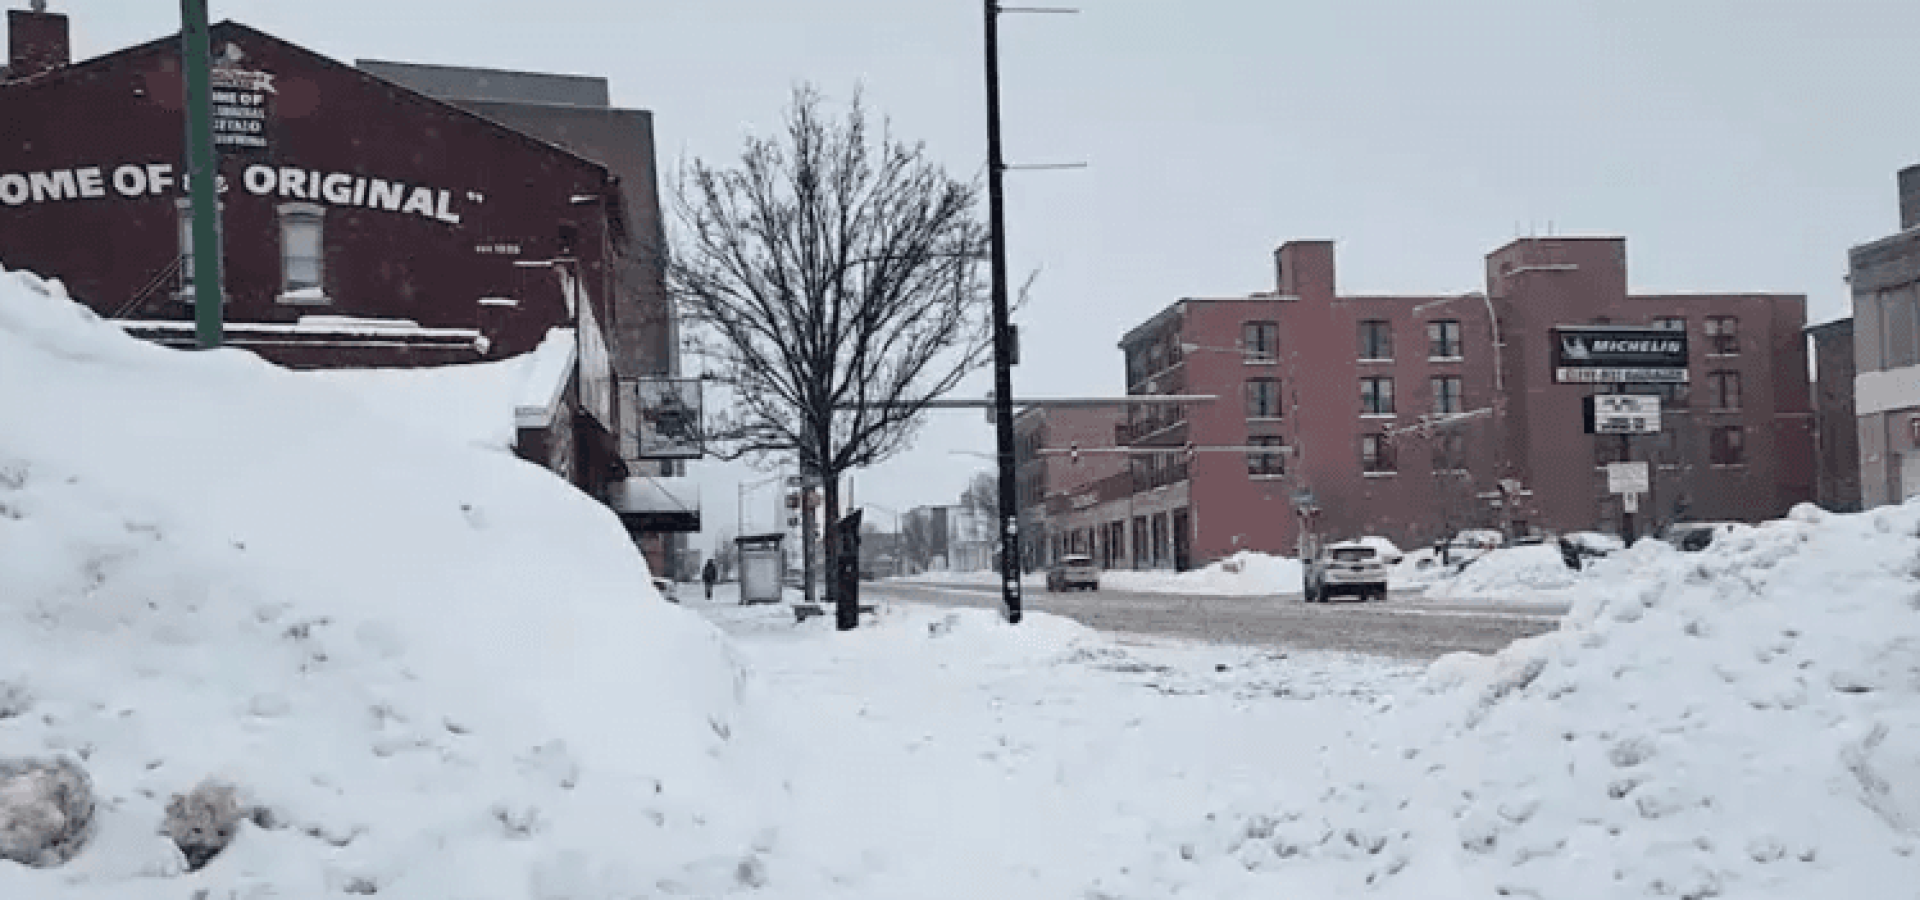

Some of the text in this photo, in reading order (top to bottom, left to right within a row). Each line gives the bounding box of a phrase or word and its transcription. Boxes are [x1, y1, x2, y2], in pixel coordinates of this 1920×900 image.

[240, 93, 264, 105] OF
[112, 163, 174, 197] OF
[1592, 340, 1680, 352] MICHELIN
